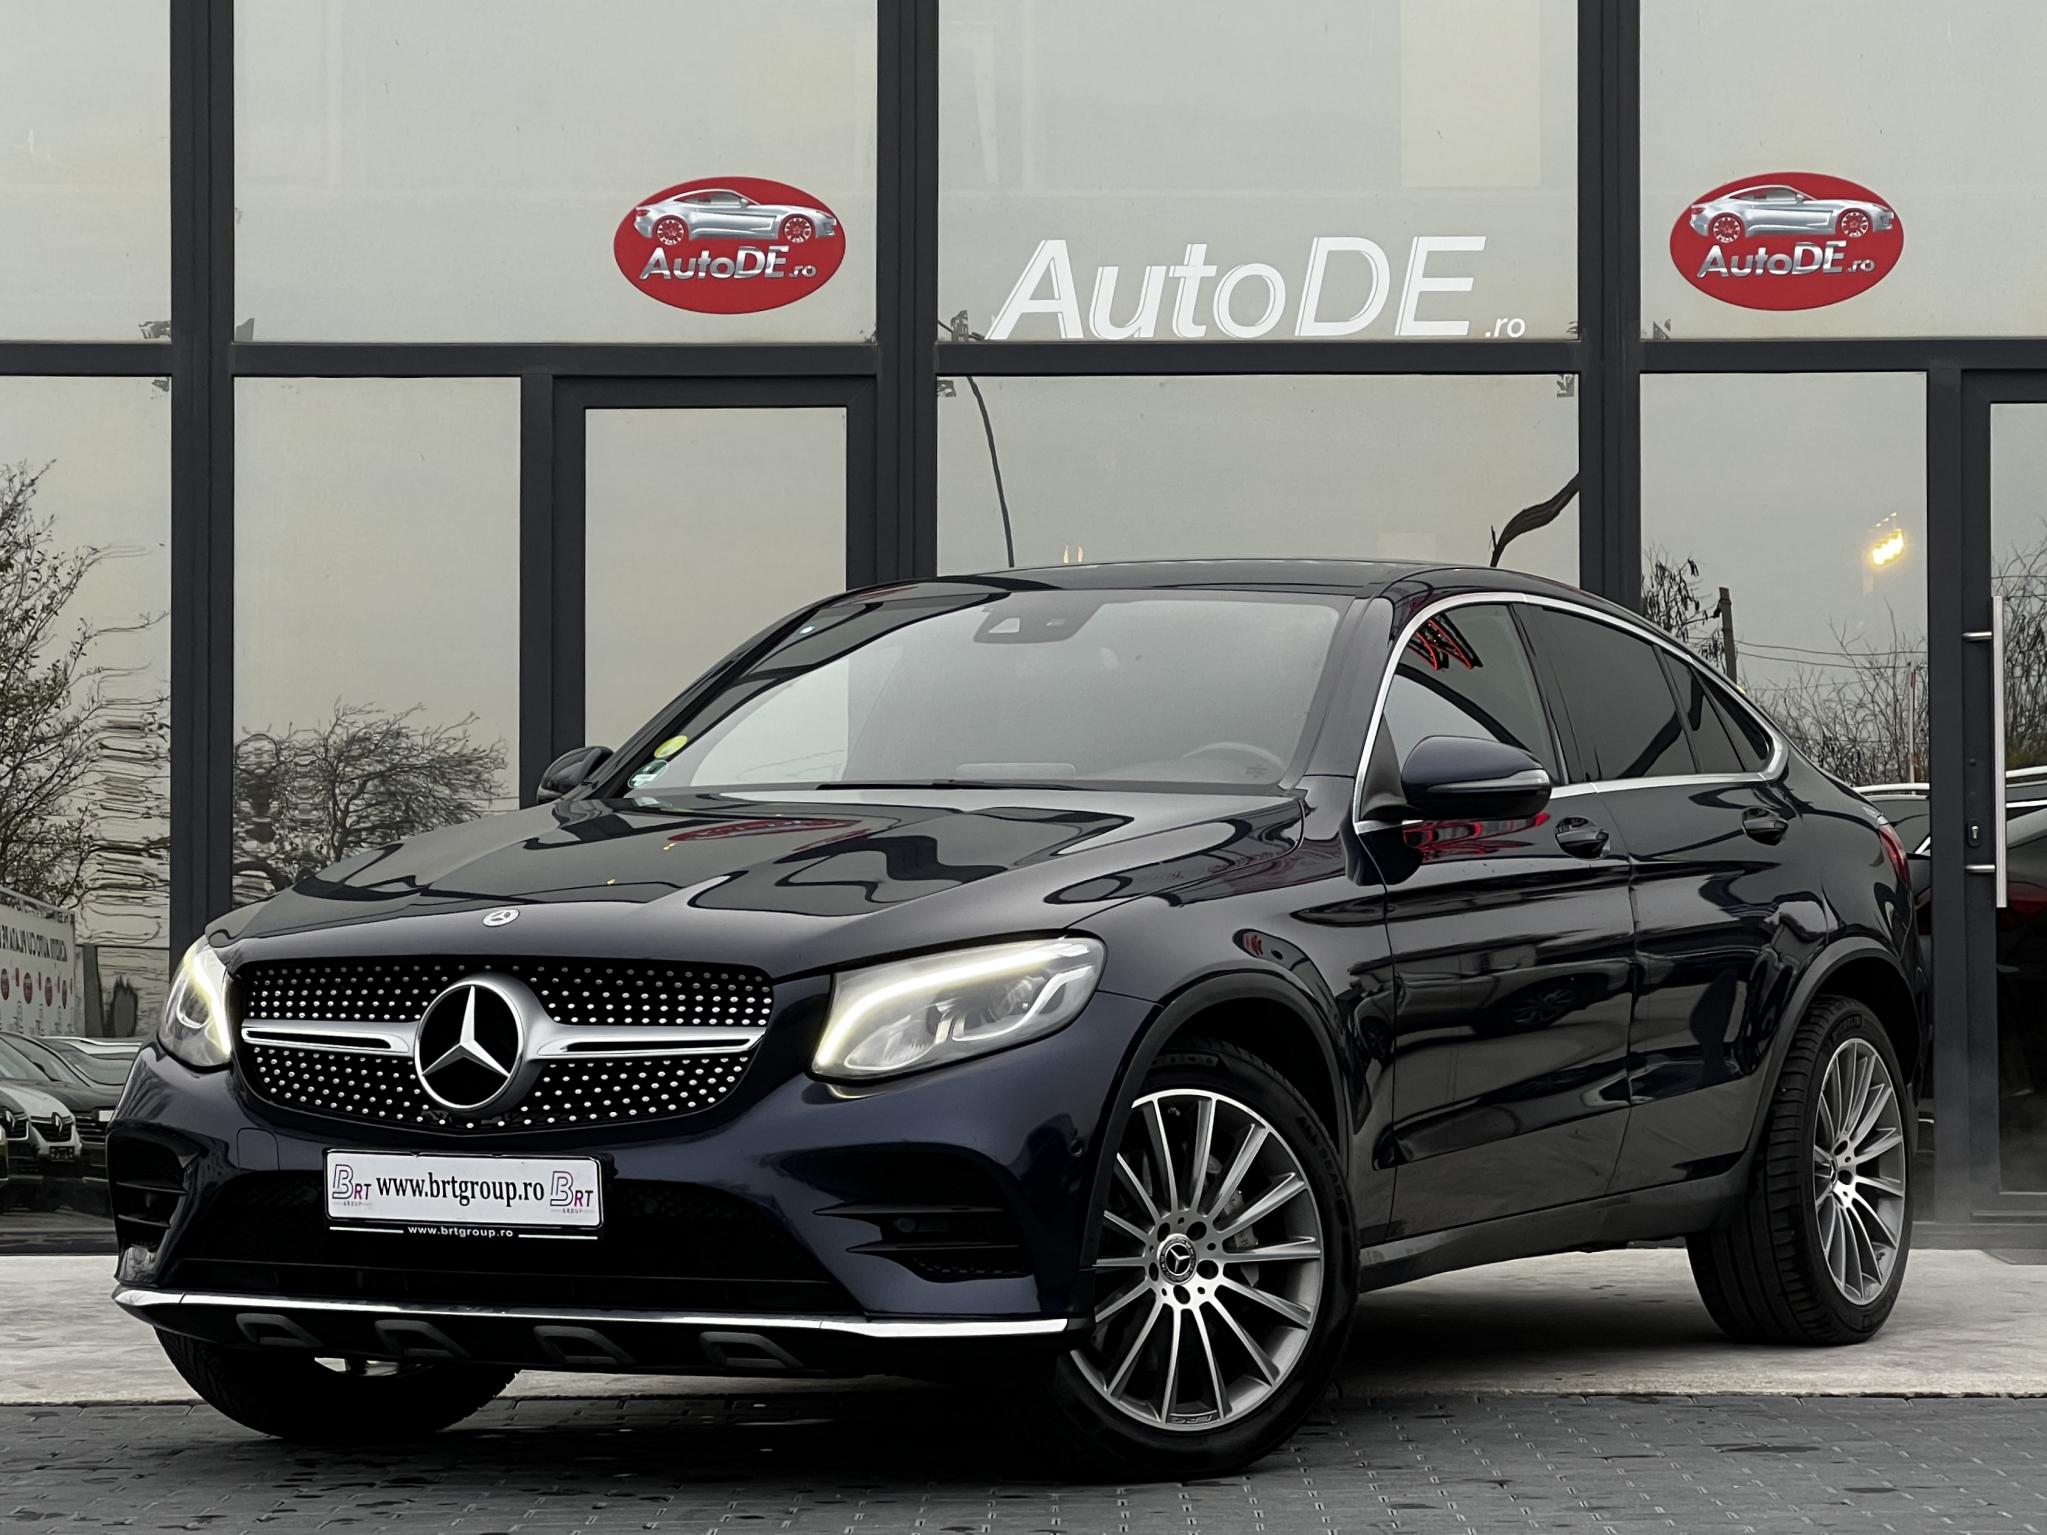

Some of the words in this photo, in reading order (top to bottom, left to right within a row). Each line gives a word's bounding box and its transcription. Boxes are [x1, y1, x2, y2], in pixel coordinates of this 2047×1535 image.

[332, 1164, 372, 1200] BRT
[376, 1172, 545, 1207] www.brtgroup.ro
[550, 1170, 594, 1207] BRT
[407, 1225, 514, 1238] www.brtgroup.ro
